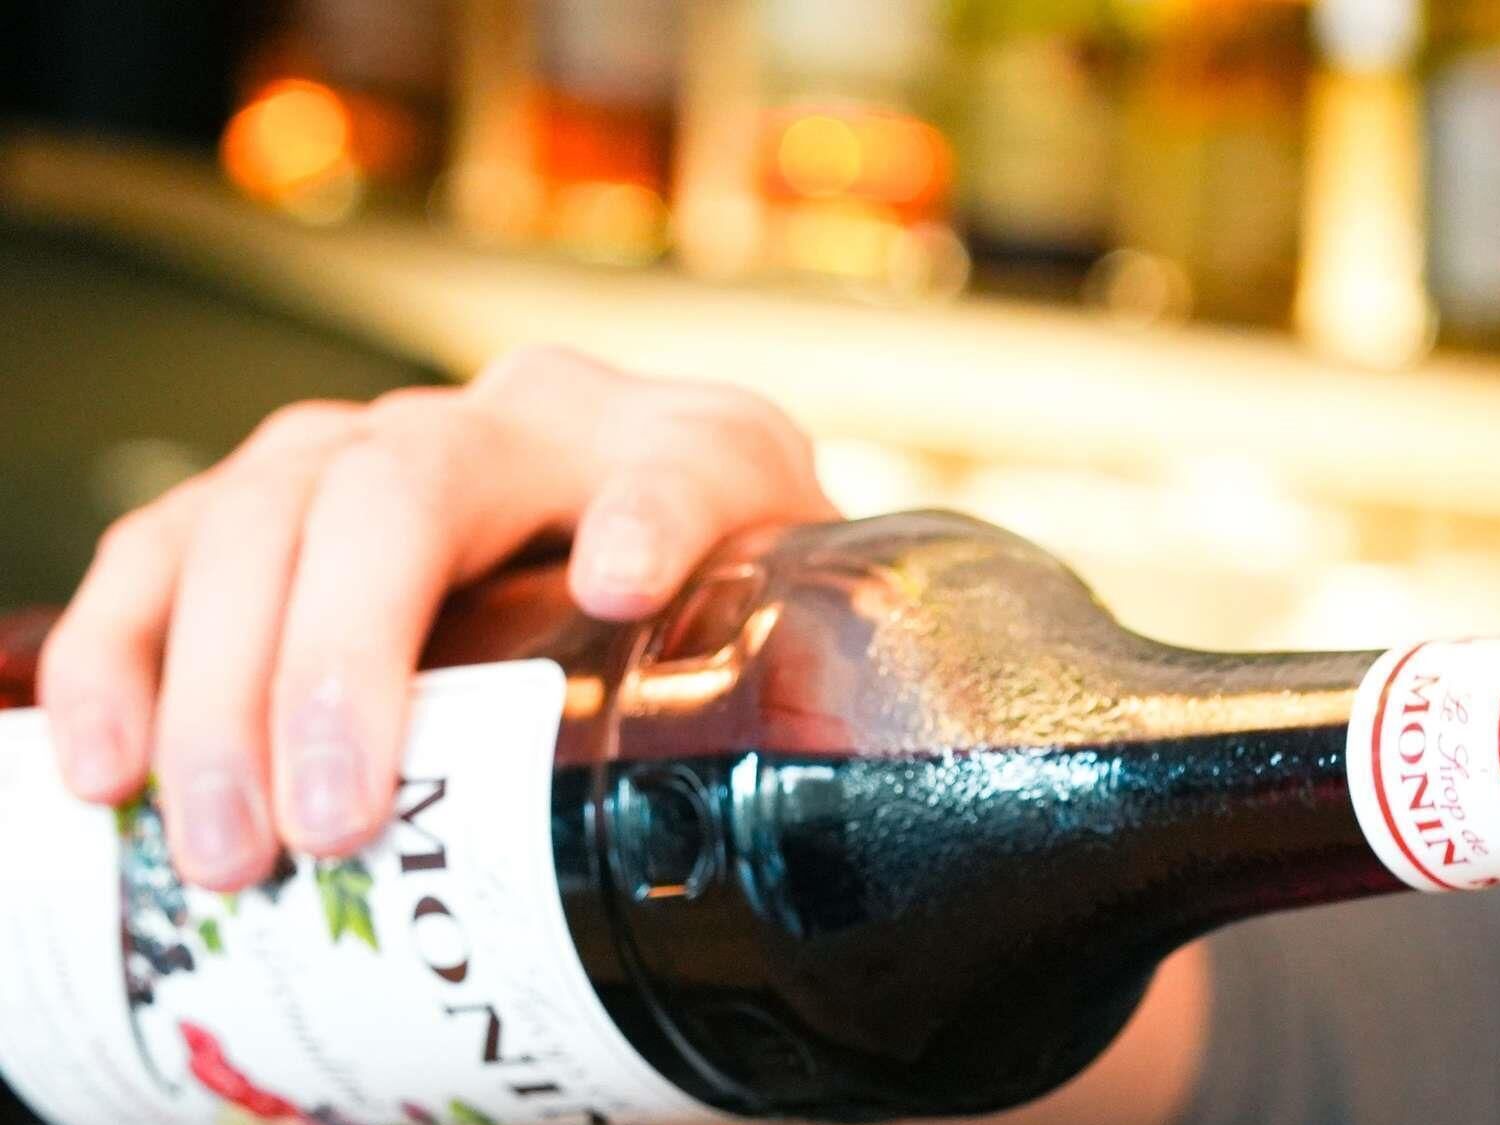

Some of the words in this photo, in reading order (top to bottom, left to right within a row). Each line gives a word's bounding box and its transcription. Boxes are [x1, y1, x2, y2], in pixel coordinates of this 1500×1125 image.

[1398, 673, 1470, 867] MONIN
[1438, 731, 1470, 822] Sirop
[1461, 828, 1490, 856] de
